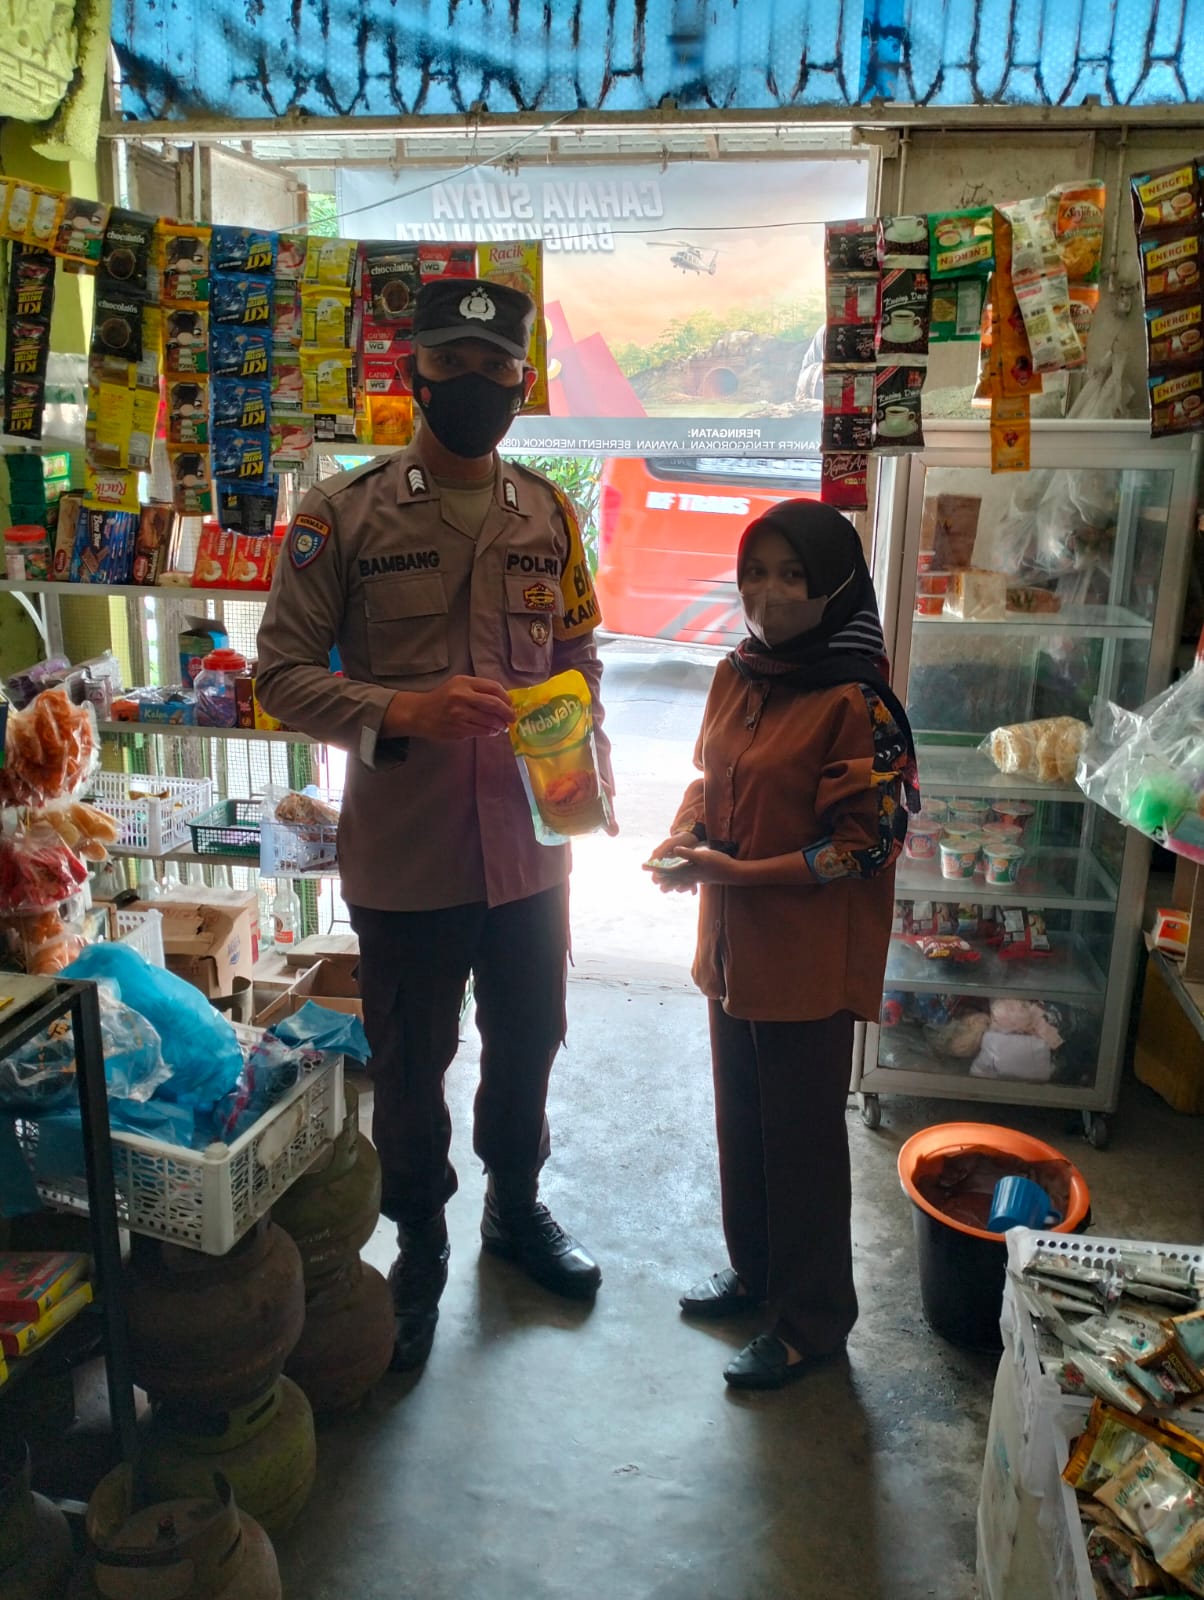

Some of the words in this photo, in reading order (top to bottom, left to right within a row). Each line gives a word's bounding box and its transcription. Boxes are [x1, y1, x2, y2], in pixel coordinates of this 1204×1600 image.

[244, 252, 273, 271] KIT
[488, 244, 525, 264] Racik
[940, 246, 988, 265] ENERGEN
[1150, 242, 1196, 264] ENERGEN
[16, 301, 42, 315] KIT
[242, 305, 269, 323] KIT
[1155, 311, 1199, 332] ENERGEN
[12, 361, 37, 375] KIT
[241, 358, 268, 376] KIT
[1157, 376, 1200, 399] ENERGEN
[9, 418, 33, 432] KIT
[241, 410, 266, 427] KIT
[239, 461, 264, 478] KIT
[95, 481, 128, 497] Racik
[358, 551, 440, 578] BAMBANG
[506, 553, 558, 577] POLRI
[519, 698, 580, 737] Hidayah
